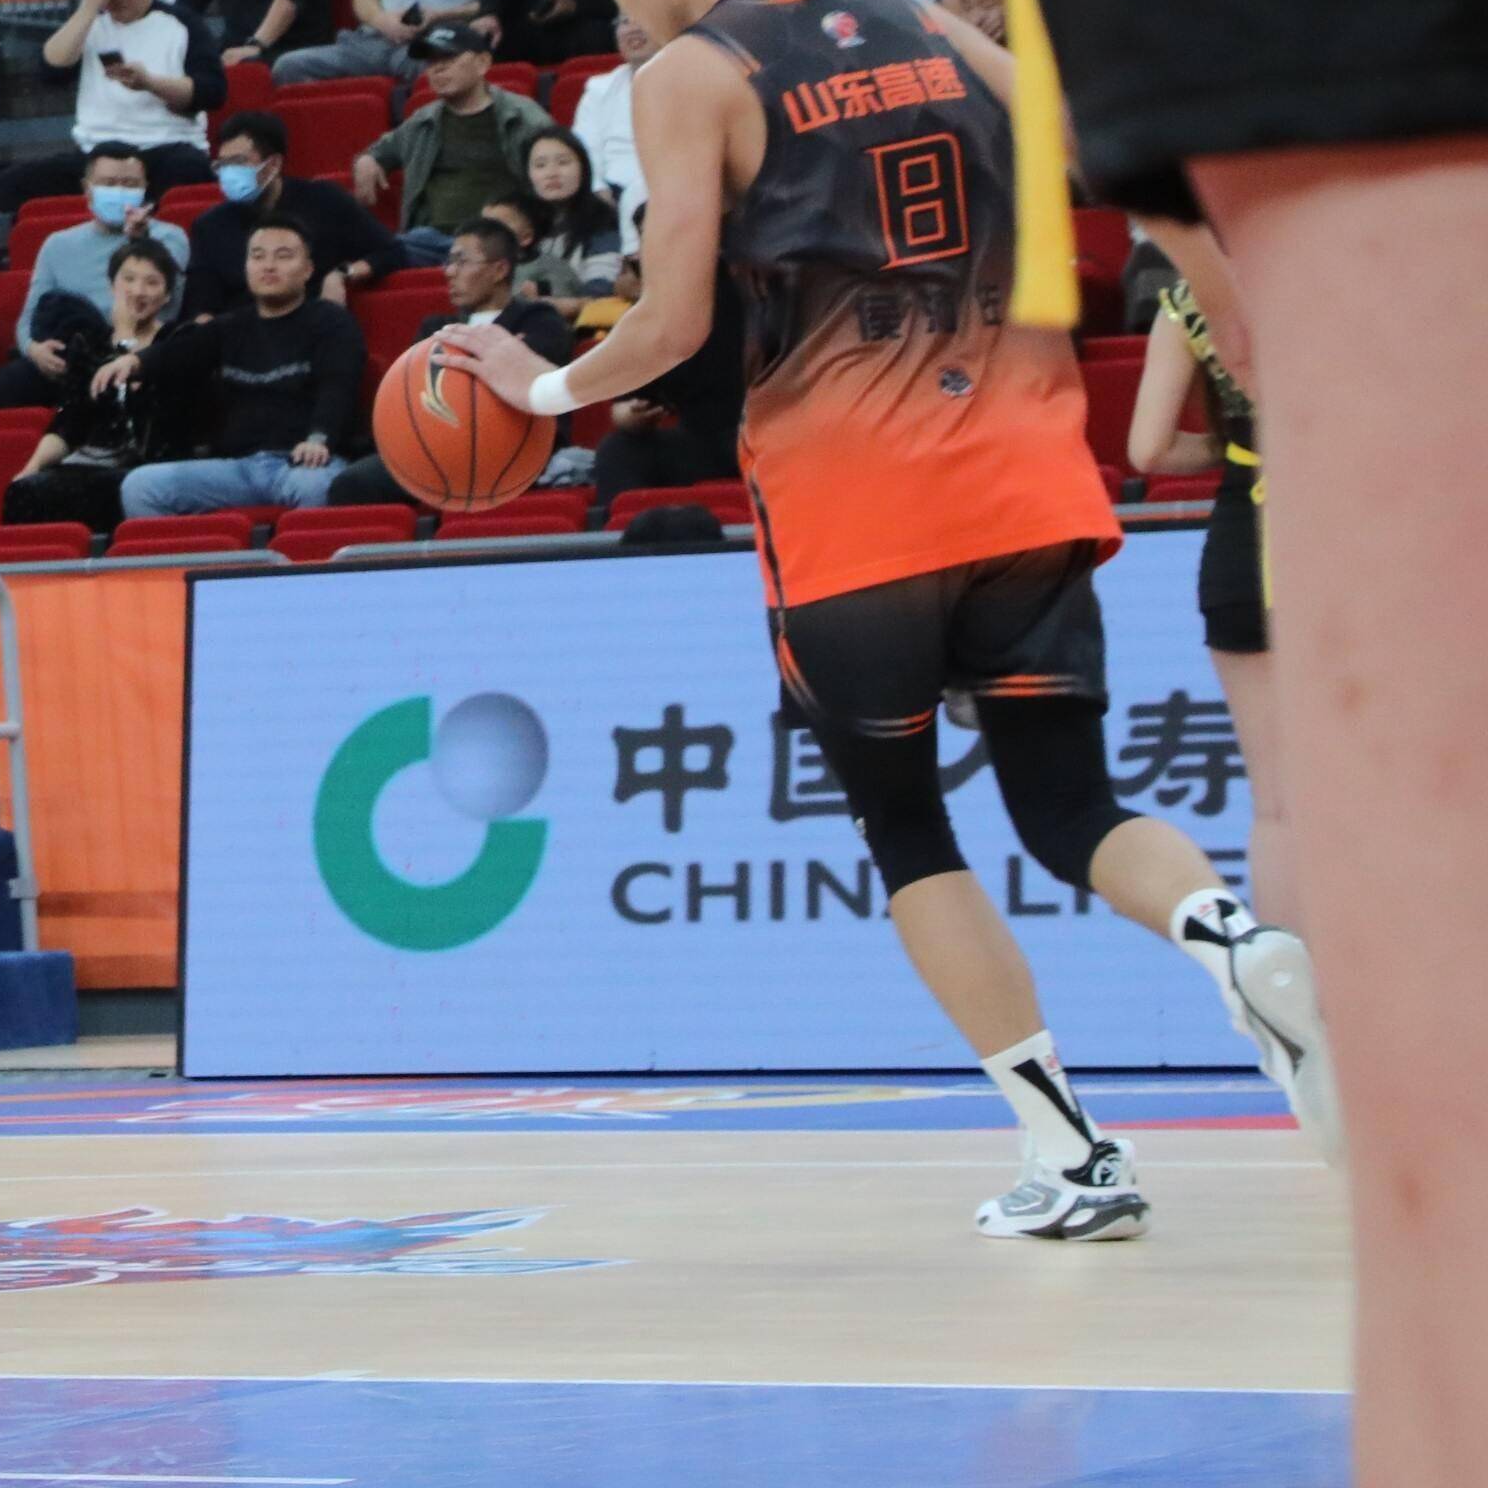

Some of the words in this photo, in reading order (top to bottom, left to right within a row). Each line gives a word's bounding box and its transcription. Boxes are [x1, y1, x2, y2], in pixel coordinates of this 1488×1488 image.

[781, 56, 967, 134] 山东高速
[866, 132, 970, 271] 8
[610, 860, 892, 925] CHIN
